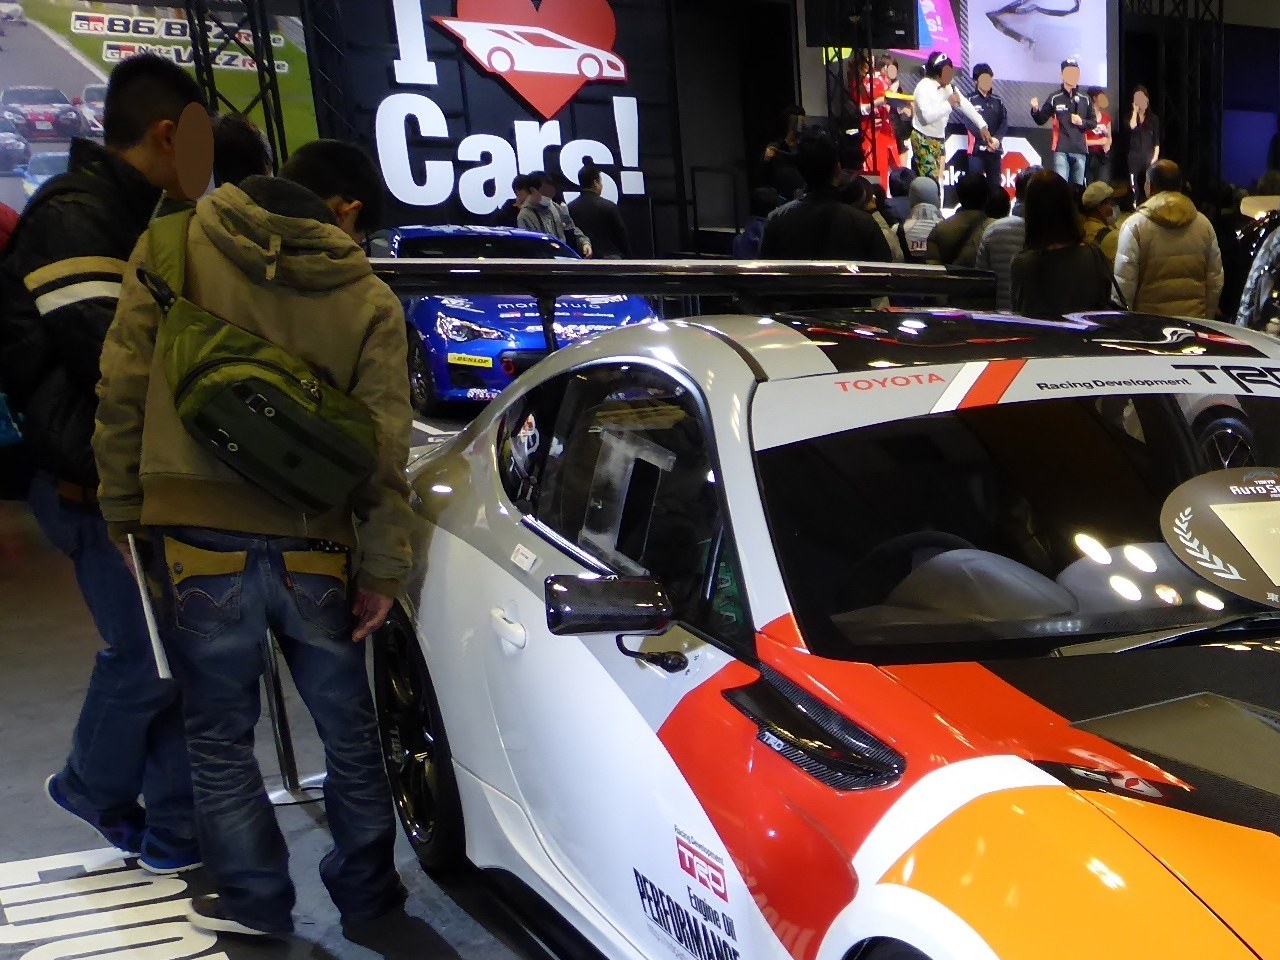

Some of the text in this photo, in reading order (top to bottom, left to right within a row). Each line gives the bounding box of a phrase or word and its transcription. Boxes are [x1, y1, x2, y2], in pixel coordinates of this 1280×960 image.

[393, 0, 438, 84] I
[376, 93, 645, 215] Cars!
[835, 372, 945, 392] TOYOTA
[1037, 377, 1192, 391] Racing Development
[677, 840, 727, 899] TRD
[687, 885, 738, 942] Engine Oil
